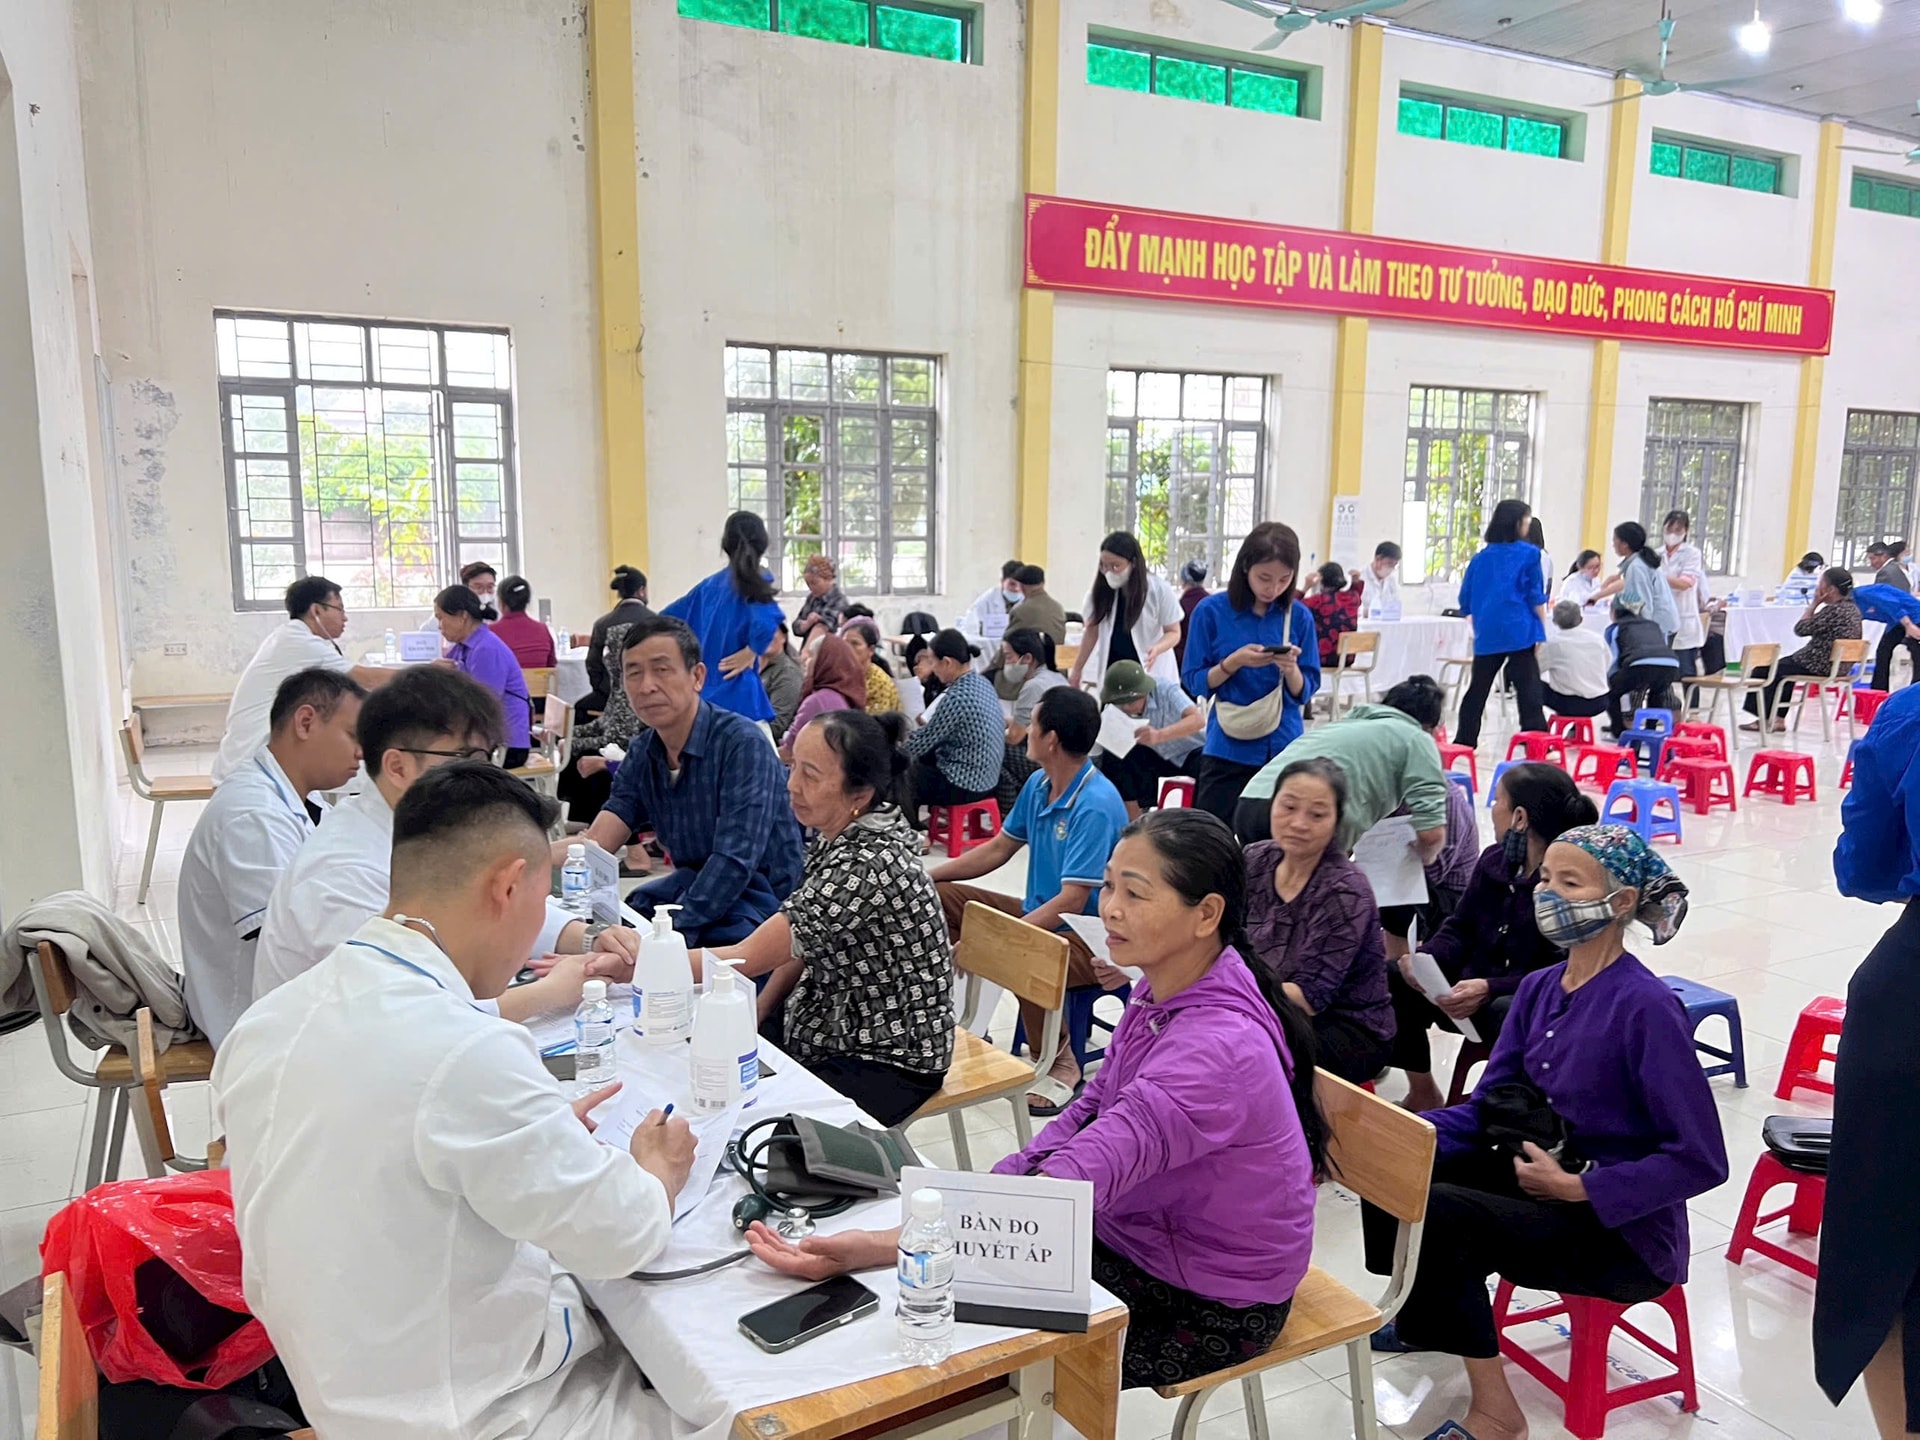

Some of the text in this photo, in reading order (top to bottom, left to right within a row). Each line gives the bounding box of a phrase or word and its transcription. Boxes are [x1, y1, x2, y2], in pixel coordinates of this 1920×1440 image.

[1085, 214, 1804, 336] ĐẨY MẠNH HỌC TẬP VÀ LÀM THEO TƯ TƯỞNG, ĐẠO ĐỨC, PHONG CÁCH HỒ CHÍ MINH
[960, 1212, 1039, 1236] BÀN ĐO
[1024, 1243, 1053, 1264] ÁP
